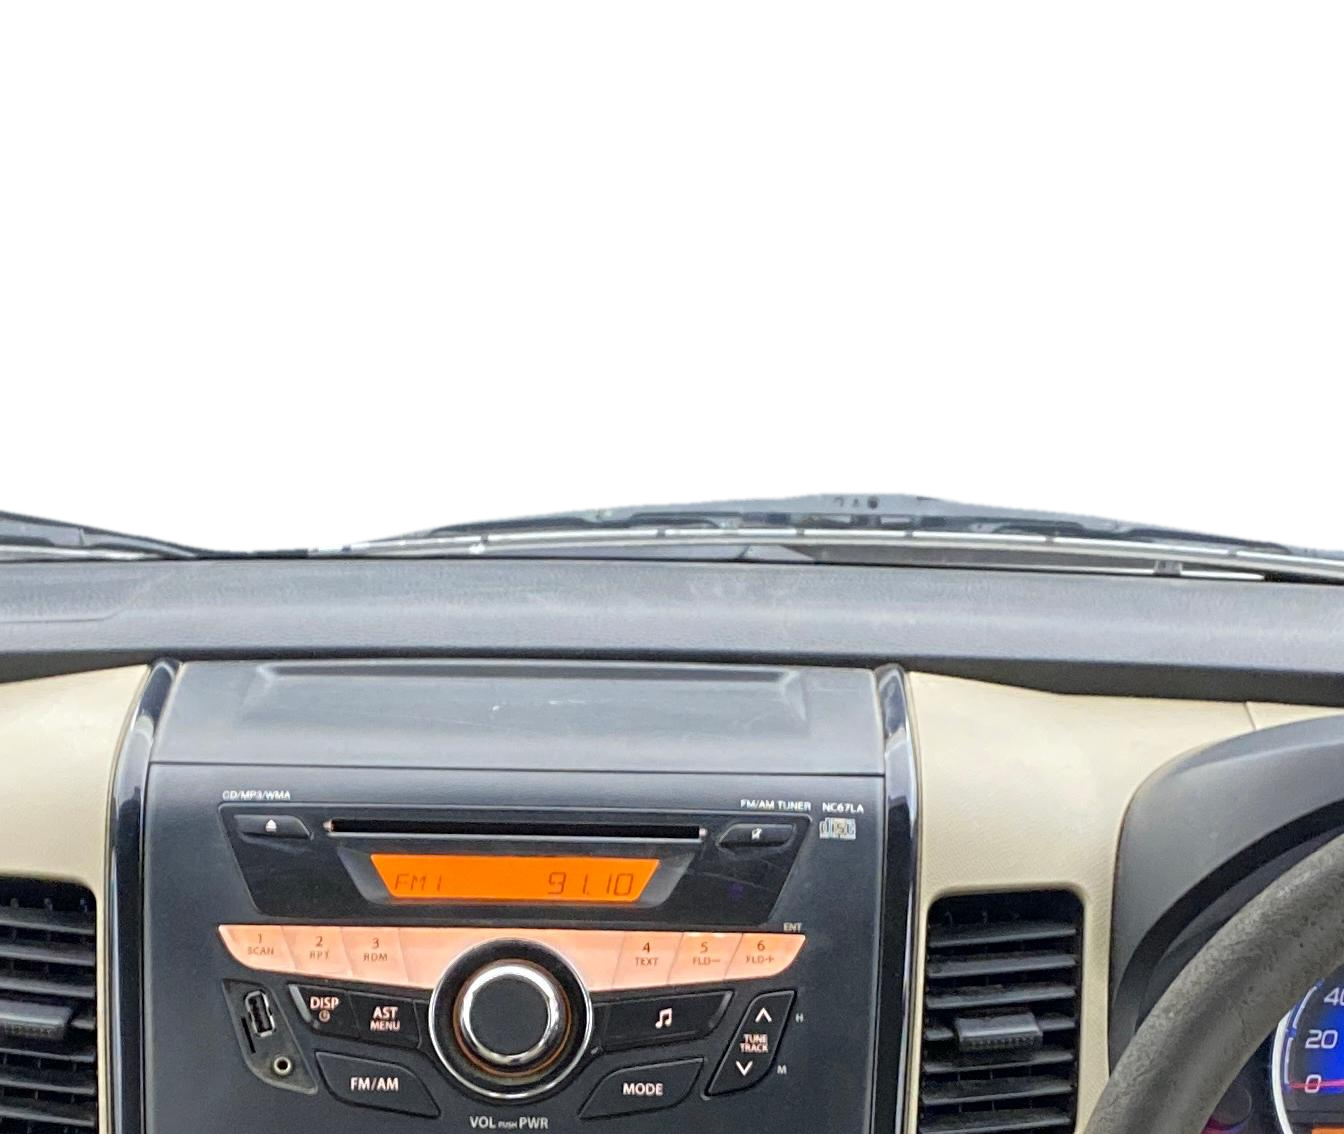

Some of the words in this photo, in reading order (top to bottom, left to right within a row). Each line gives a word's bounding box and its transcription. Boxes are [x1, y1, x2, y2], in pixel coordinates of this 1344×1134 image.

[740, 799, 775, 810] FM/AM
[777, 801, 811, 812] TUNER
[822, 802, 864, 814] NC67LA
[783, 922, 802, 933] ENT
[257, 933, 263, 944] 1
[316, 936, 323, 948] 2
[372, 938, 380, 949] 3
[247, 946, 274, 956] SCAN
[642, 942, 651, 953] 4
[701, 942, 709, 953] 5
[757, 940, 765, 951] 6
[309, 950, 330, 960] RPT
[363, 952, 388, 962] RDM
[635, 957, 659, 966] TEXT
[310, 997, 339, 1010] DISP
[372, 1006, 398, 1020] AST
[795, 1013, 804, 1023] H
[370, 1020, 401, 1031] MENU
[744, 1034, 768, 1043] TUNE
[1305, 1030, 1338, 1049] 20
[740, 1043, 769, 1053] TRACK
[777, 1064, 787, 1075] M
[350, 1077, 399, 1091] FM/AM
[622, 1083, 664, 1096] MODE
[1305, 1074, 1322, 1094] 0
[470, 1116, 496, 1129] VOL
[519, 1117, 549, 1129] PWR
